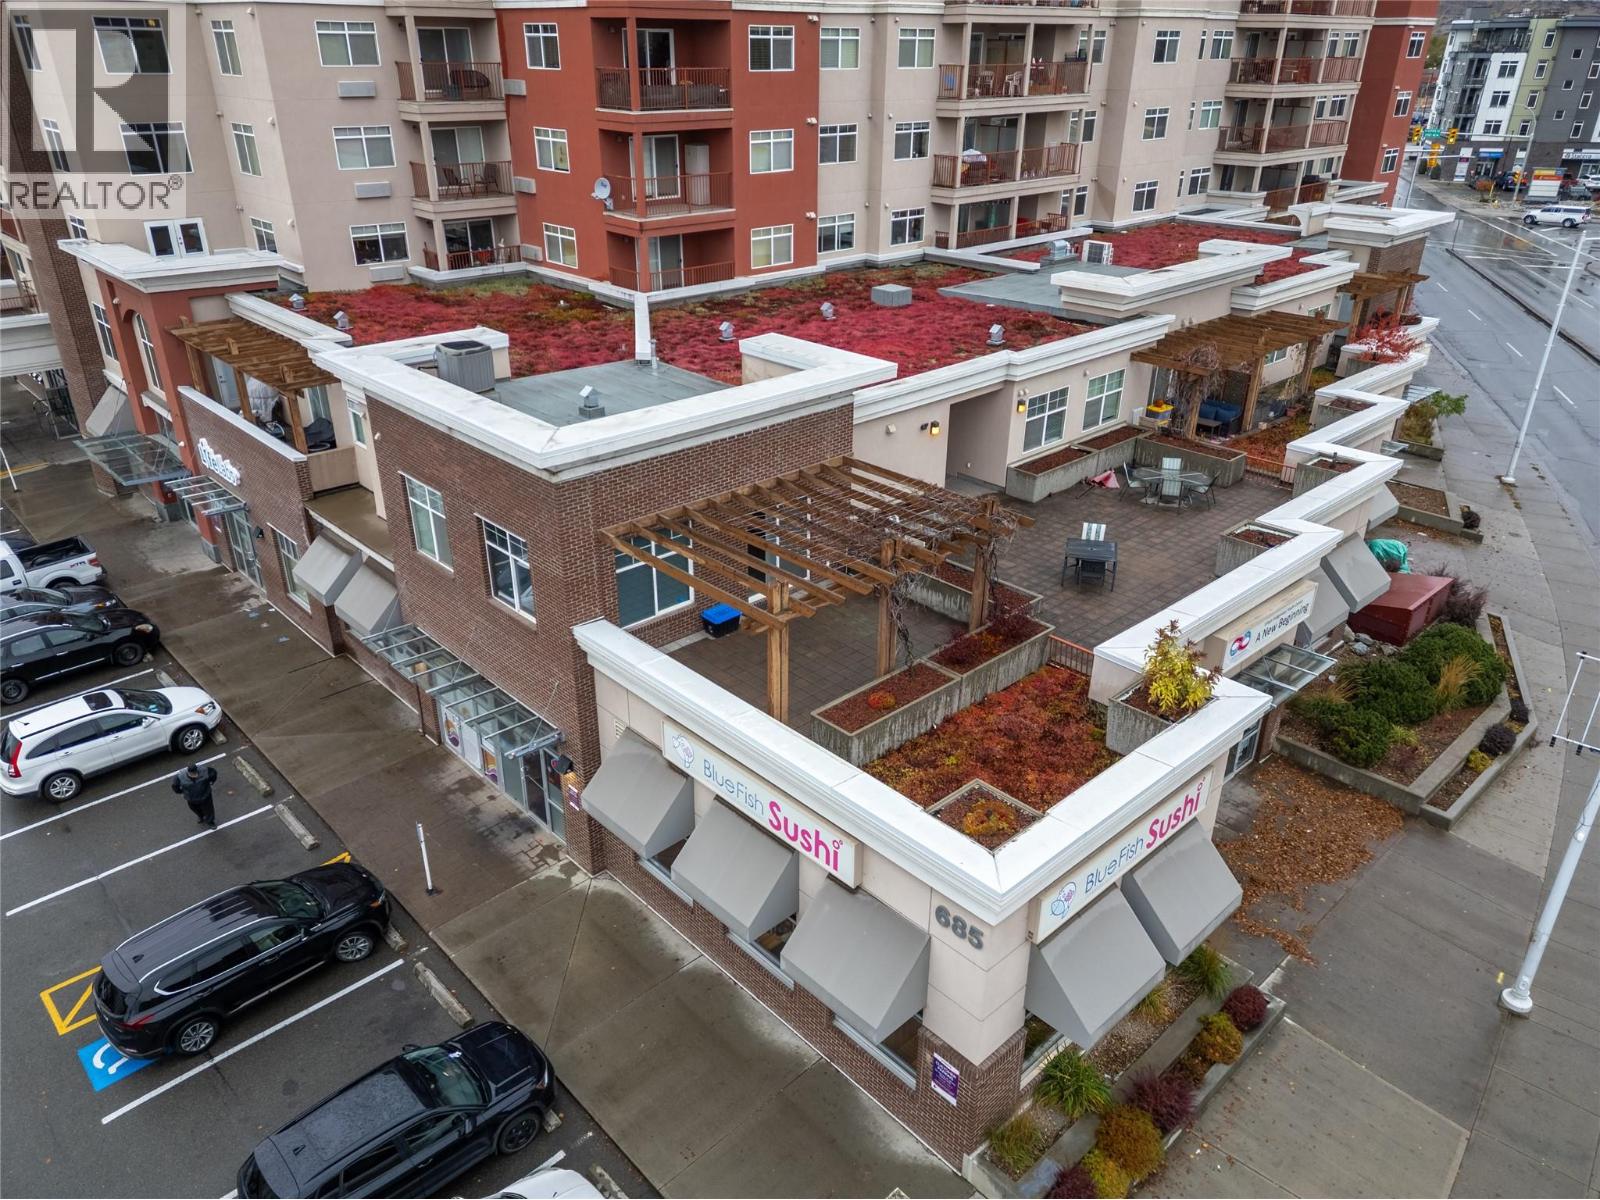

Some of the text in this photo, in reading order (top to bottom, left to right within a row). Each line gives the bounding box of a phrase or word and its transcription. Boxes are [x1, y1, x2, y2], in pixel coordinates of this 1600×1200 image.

[1254, 632, 1261, 643] A
[1262, 623, 1278, 639] New
[1279, 602, 1310, 629] Beginning
[768, 800, 843, 872] Sushi
[1146, 777, 1207, 849] Sushi
[935, 904, 984, 950] 685
